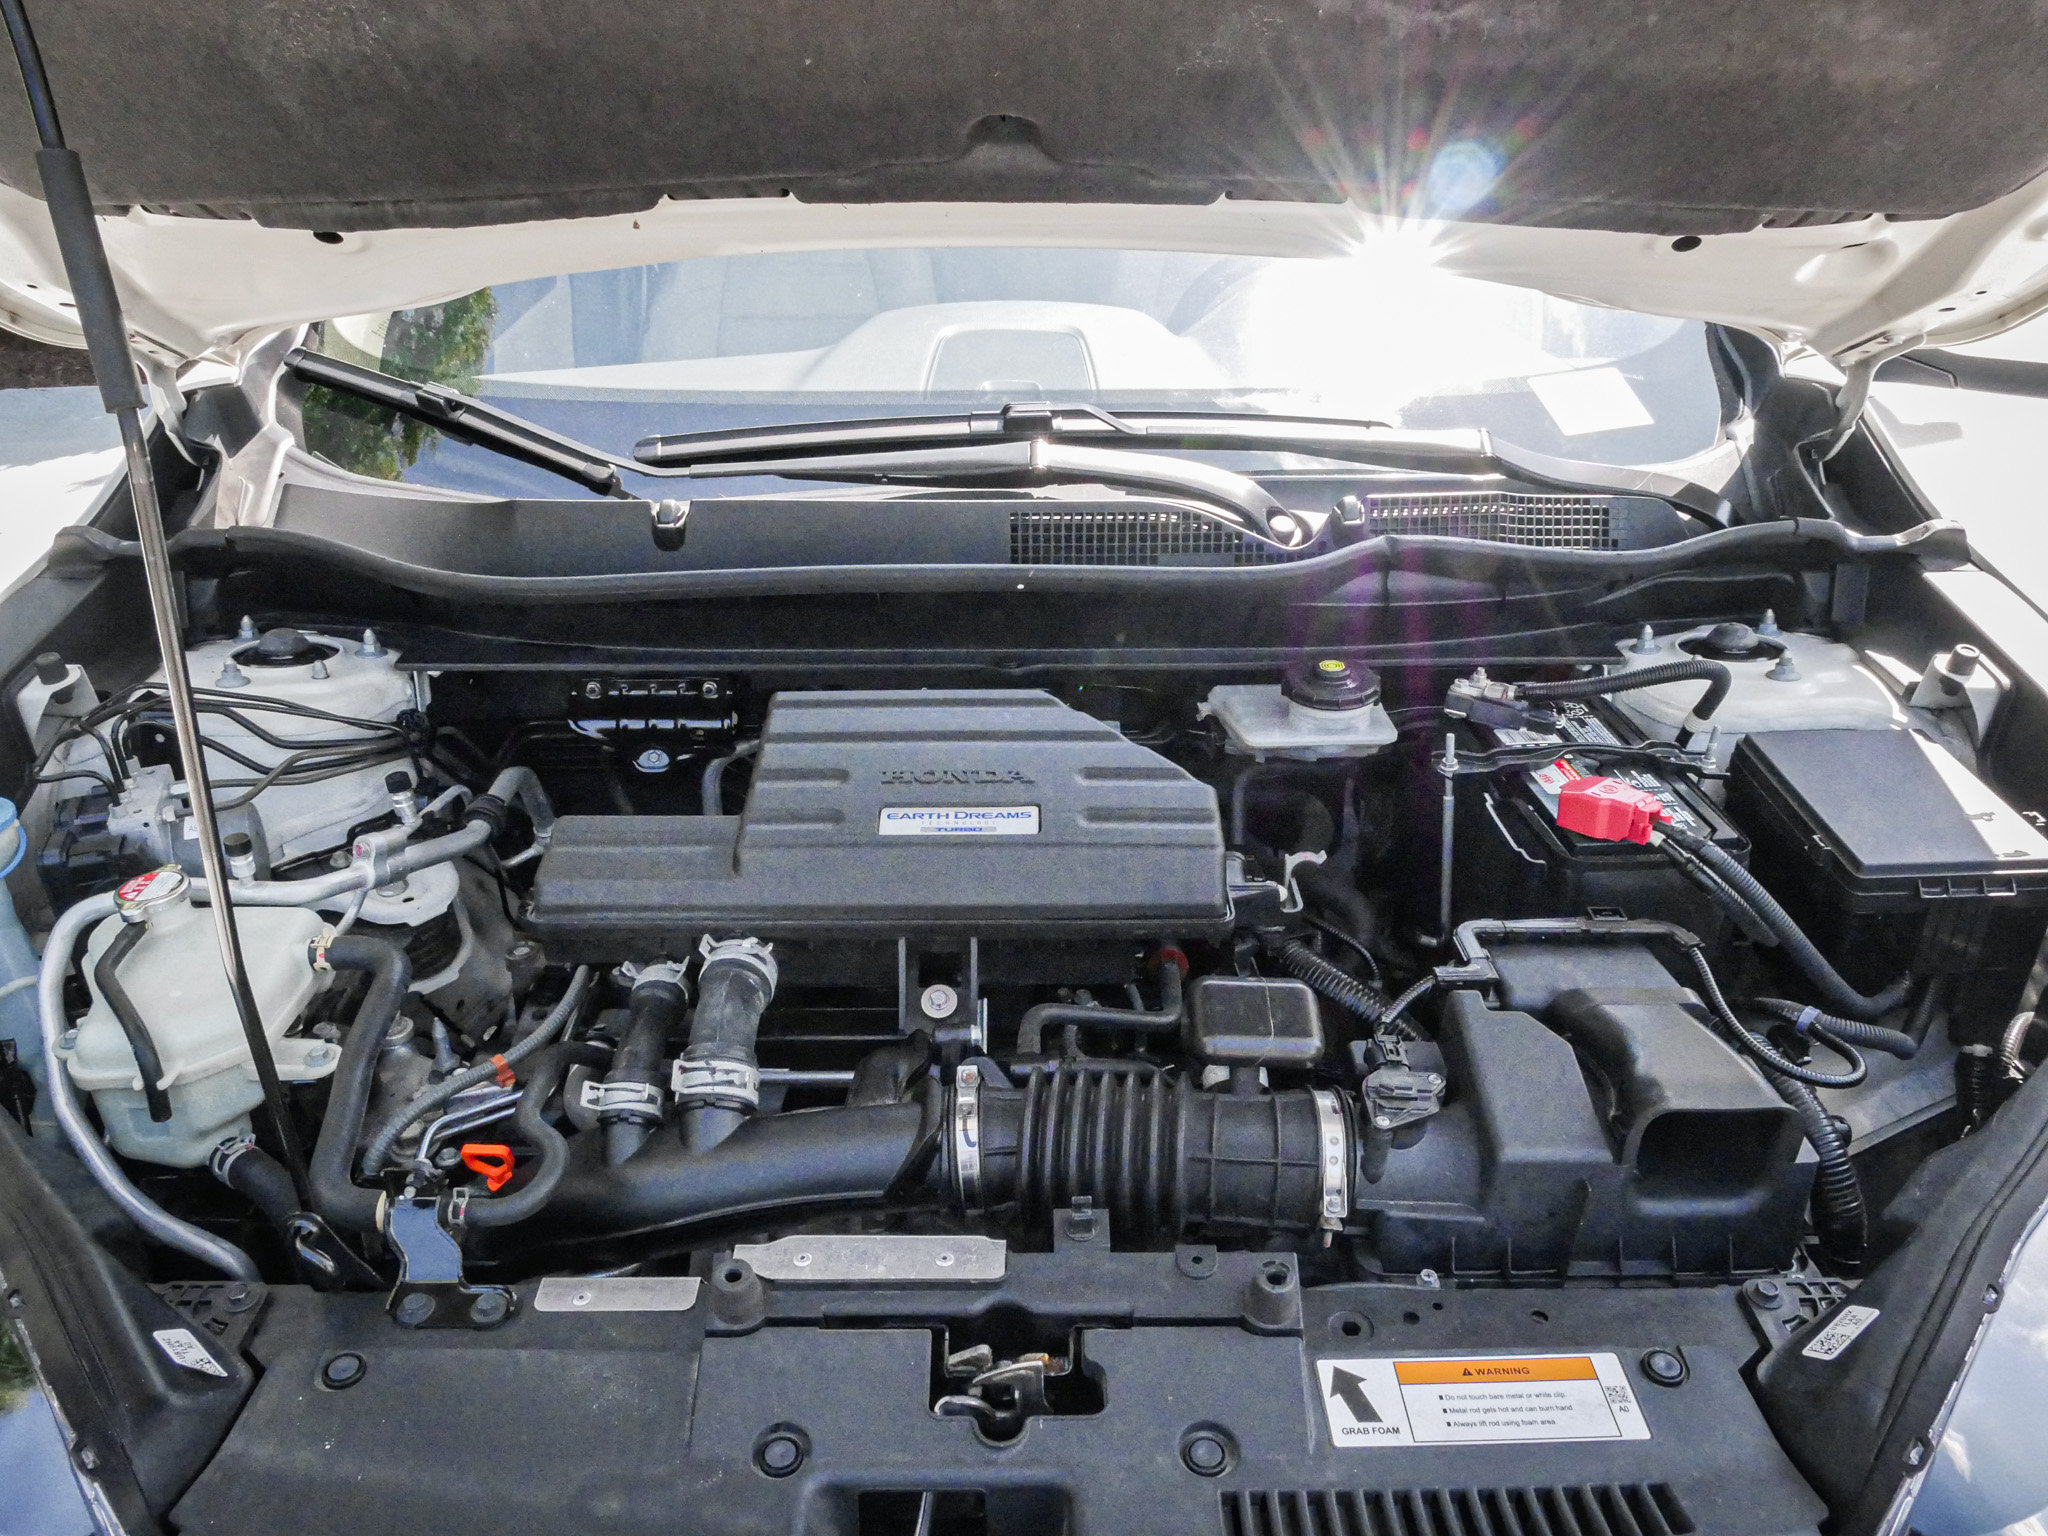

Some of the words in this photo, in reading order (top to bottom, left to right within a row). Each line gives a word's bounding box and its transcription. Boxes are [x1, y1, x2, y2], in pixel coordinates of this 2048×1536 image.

[880, 769, 1036, 785] HONDA
[886, 812, 950, 820] EARTH
[1475, 1367, 1530, 1376] WARNING
[1456, 1393, 1468, 1401] not
[1468, 1393, 1488, 1401] touch
[1453, 1420, 1477, 1428] Always
[1341, 1427, 1370, 1435] GRAB
[1371, 1426, 1400, 1435] FOAM
